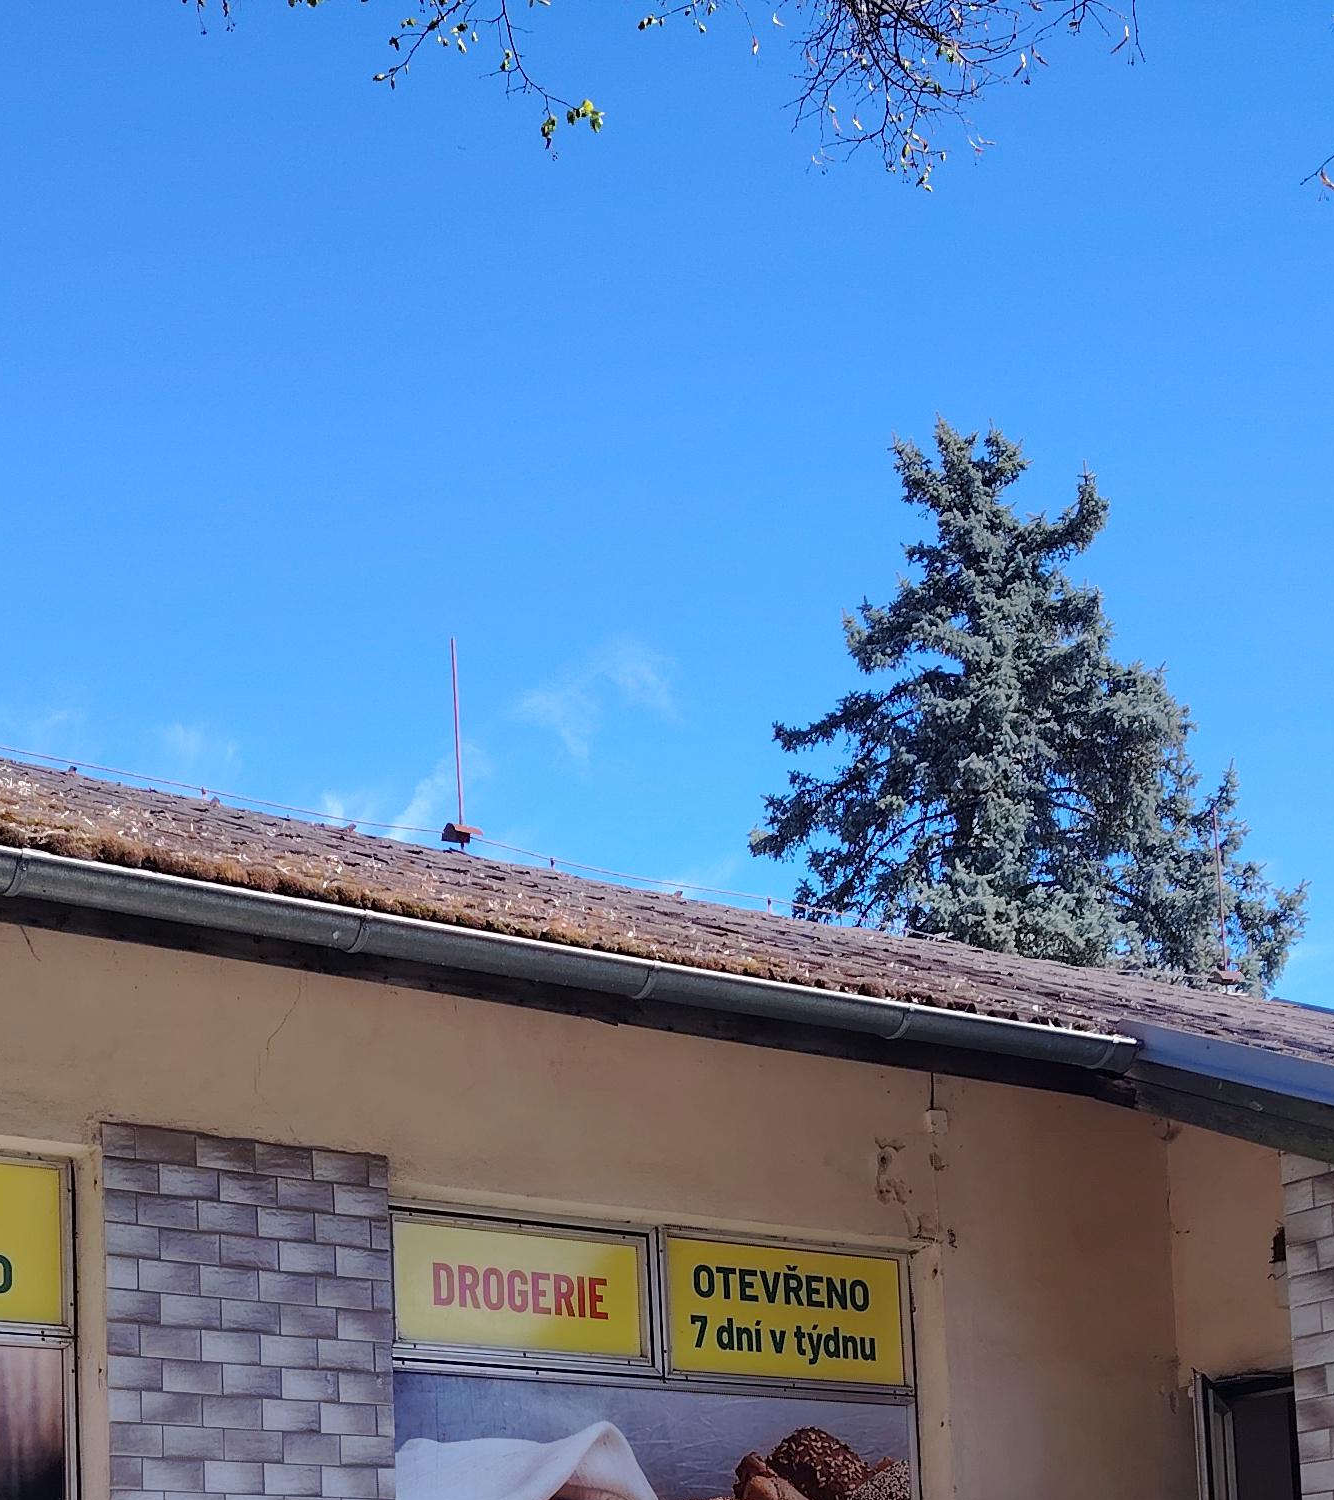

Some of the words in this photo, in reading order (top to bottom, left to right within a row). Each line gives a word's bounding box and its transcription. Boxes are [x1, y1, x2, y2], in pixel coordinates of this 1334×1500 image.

[431, 1261, 609, 1321] DROGERIE
[693, 1264, 871, 1312] OTEVŘENO
[690, 1315, 708, 1349] 7
[716, 1317, 762, 1354] dní
[770, 1327, 787, 1355] v
[794, 1325, 877, 1365] týdnu
